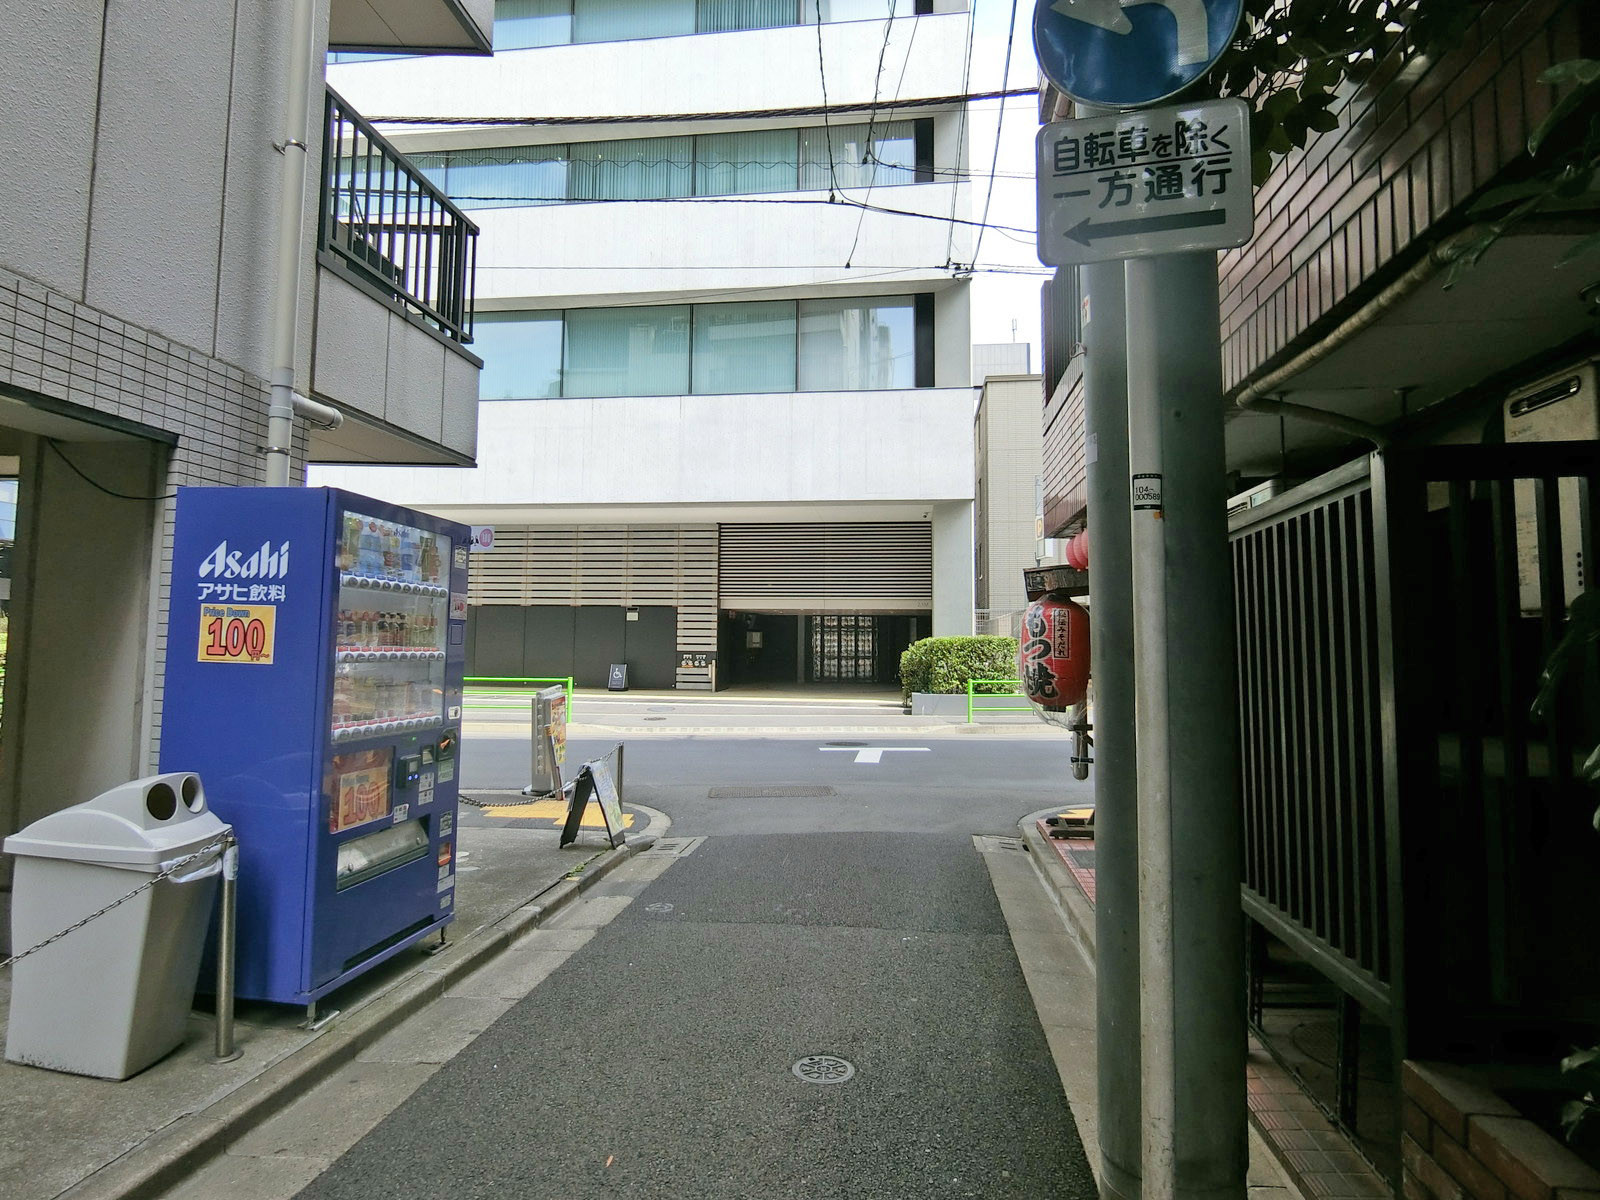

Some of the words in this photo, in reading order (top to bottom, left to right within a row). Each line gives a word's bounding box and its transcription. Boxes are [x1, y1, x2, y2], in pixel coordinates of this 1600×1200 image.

[1053, 120, 1231, 172] 自転車を除く
[1053, 157, 1232, 209] 一方通行
[198, 540, 290, 579] Asahi
[197, 583, 286, 602] アサヒ飲料
[203, 607, 225, 617] Price
[226, 607, 250, 618] Down
[1023, 606, 1058, 699] もつ焼
